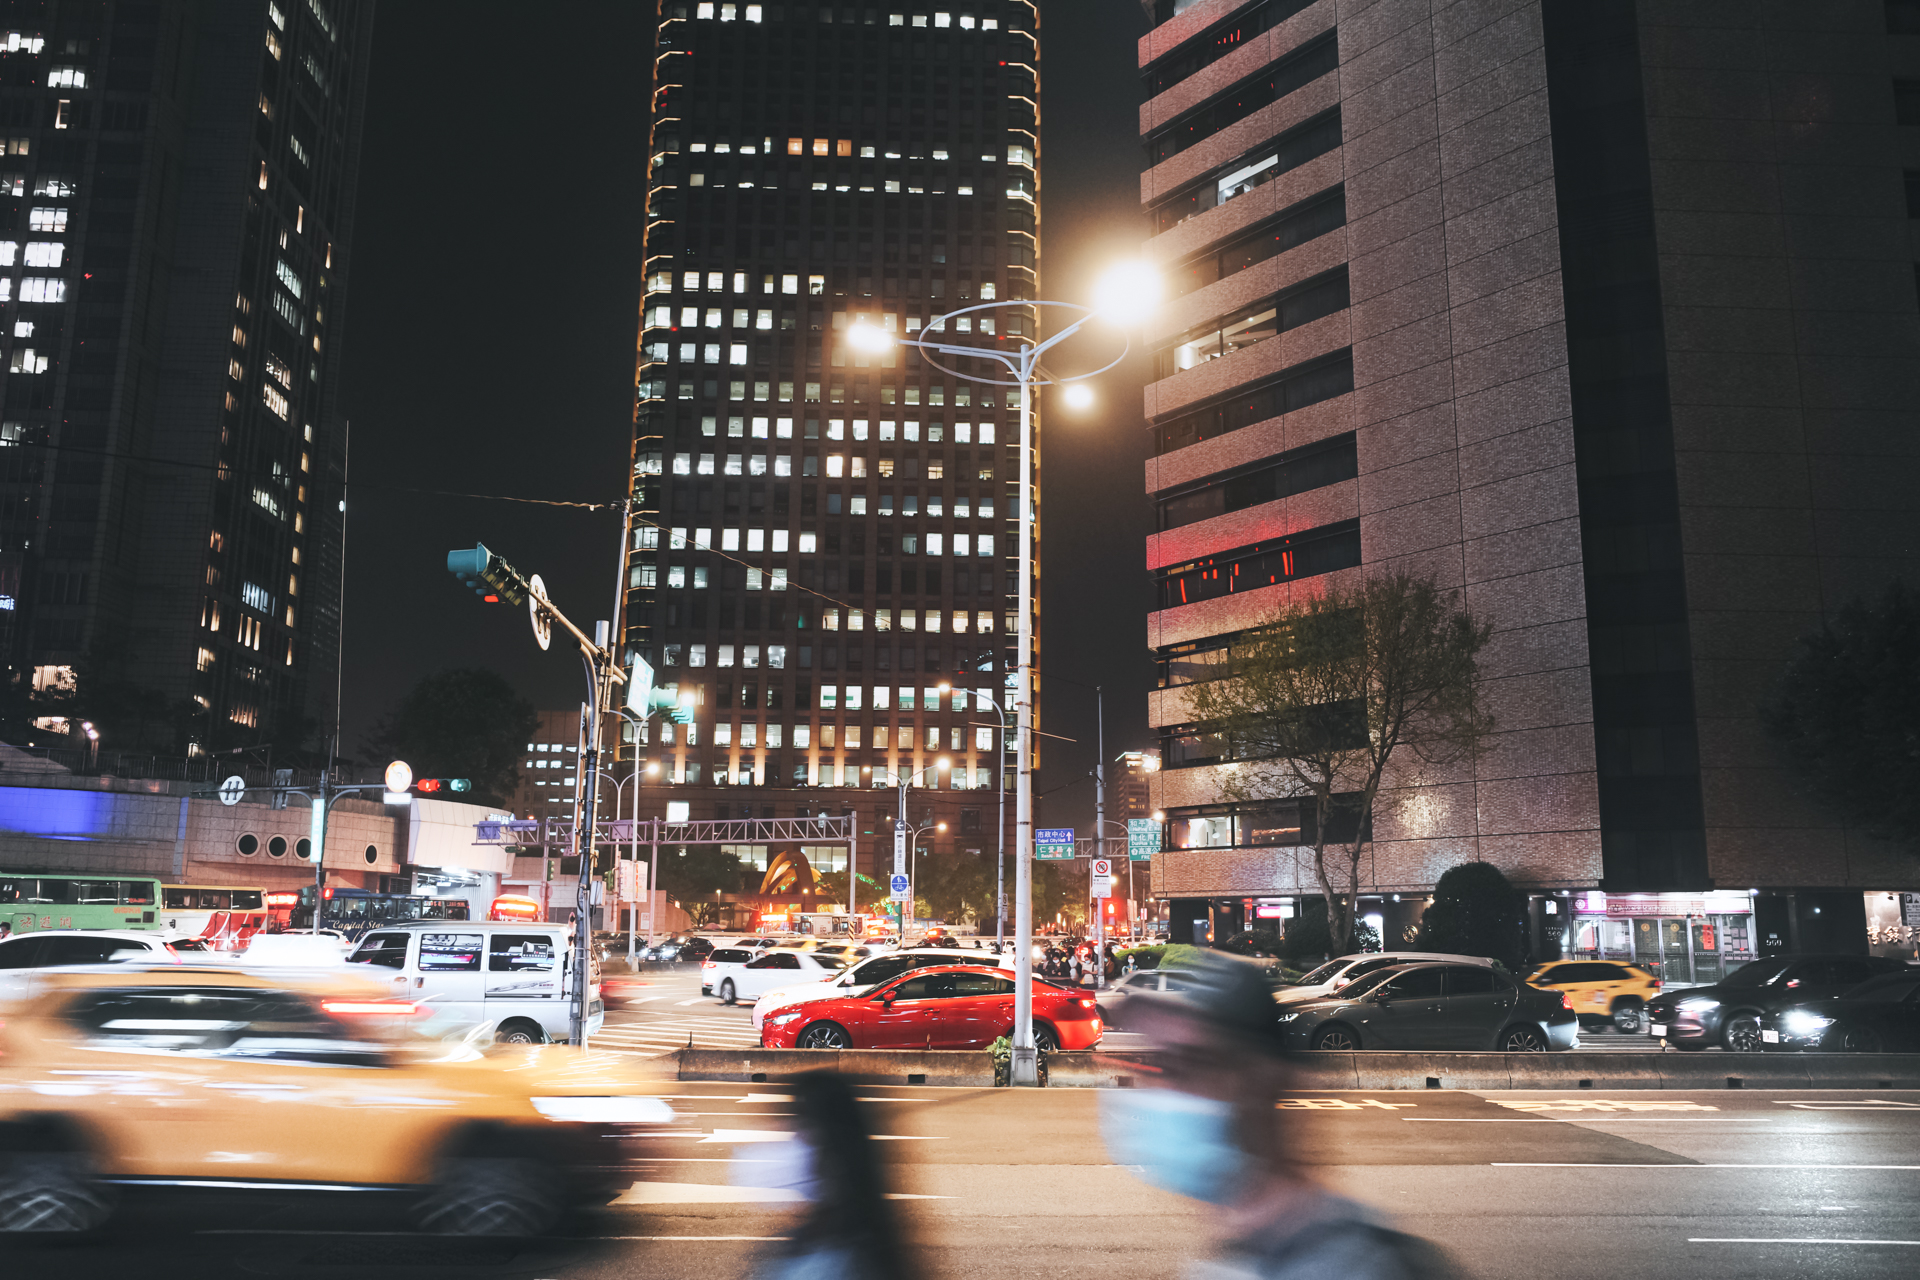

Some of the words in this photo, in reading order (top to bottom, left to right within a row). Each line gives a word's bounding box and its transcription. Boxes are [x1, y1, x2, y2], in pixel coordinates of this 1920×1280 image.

[1037, 830, 1066, 838] 市政中心
[1138, 847, 1161, 855] 高速公
[332, 920, 366, 931] Capital
